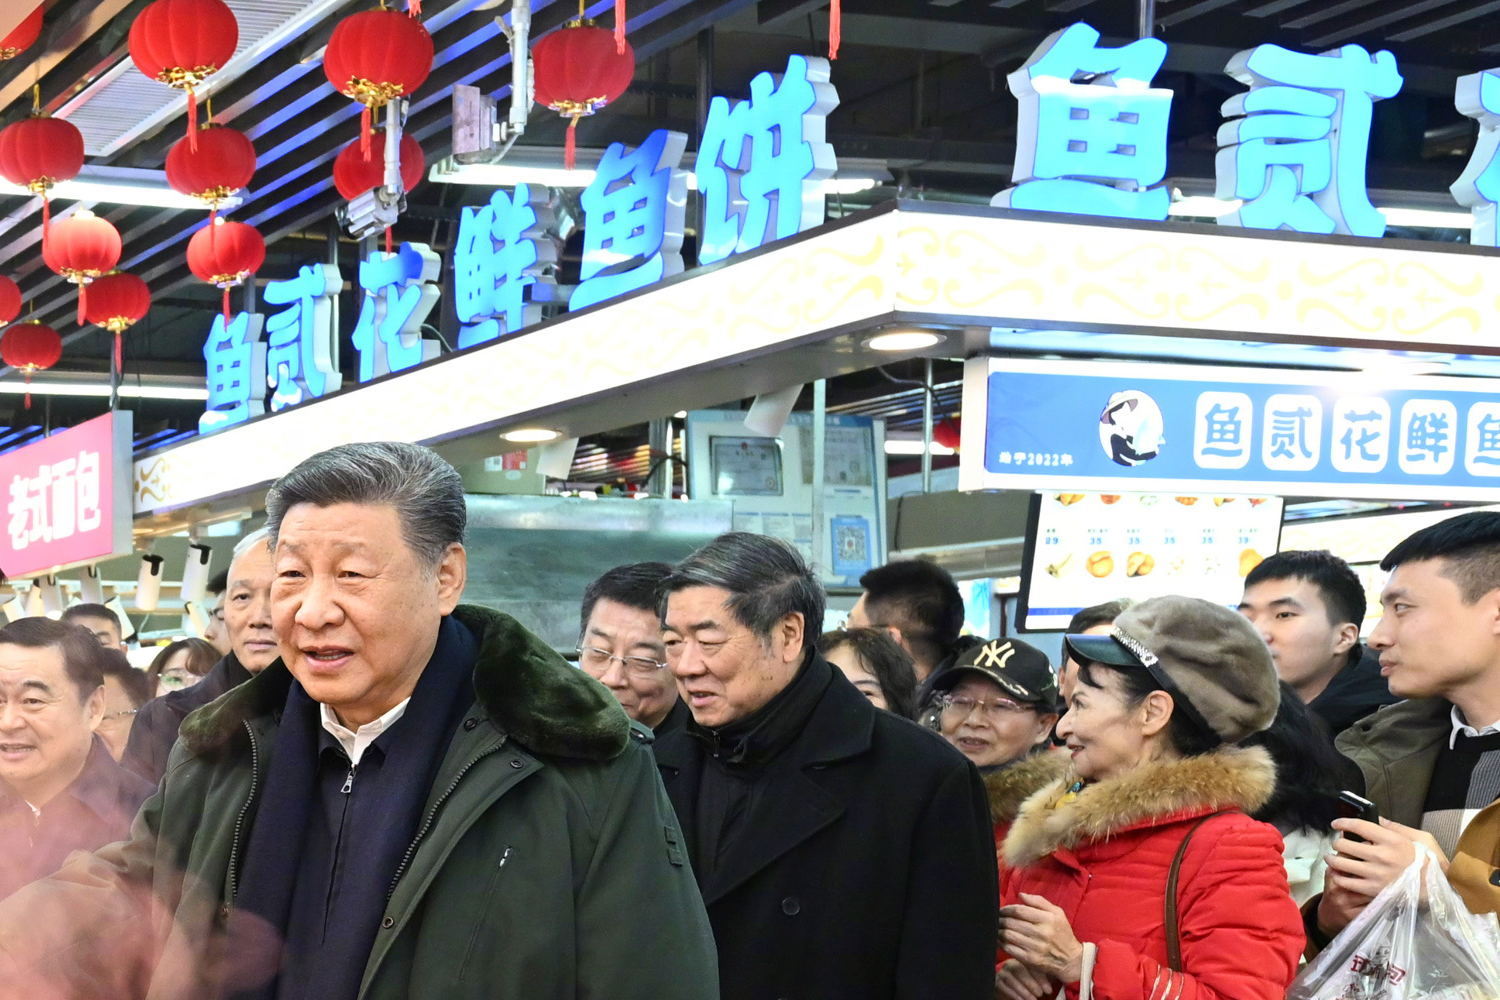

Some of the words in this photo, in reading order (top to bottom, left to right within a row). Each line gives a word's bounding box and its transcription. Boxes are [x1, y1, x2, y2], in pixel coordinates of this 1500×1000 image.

[199, 54, 834, 434] 鱼贰花鲜鱼饼
[1005, 22, 1500, 247] 鱼贰
[8, 450, 101, 551] 老式面包
